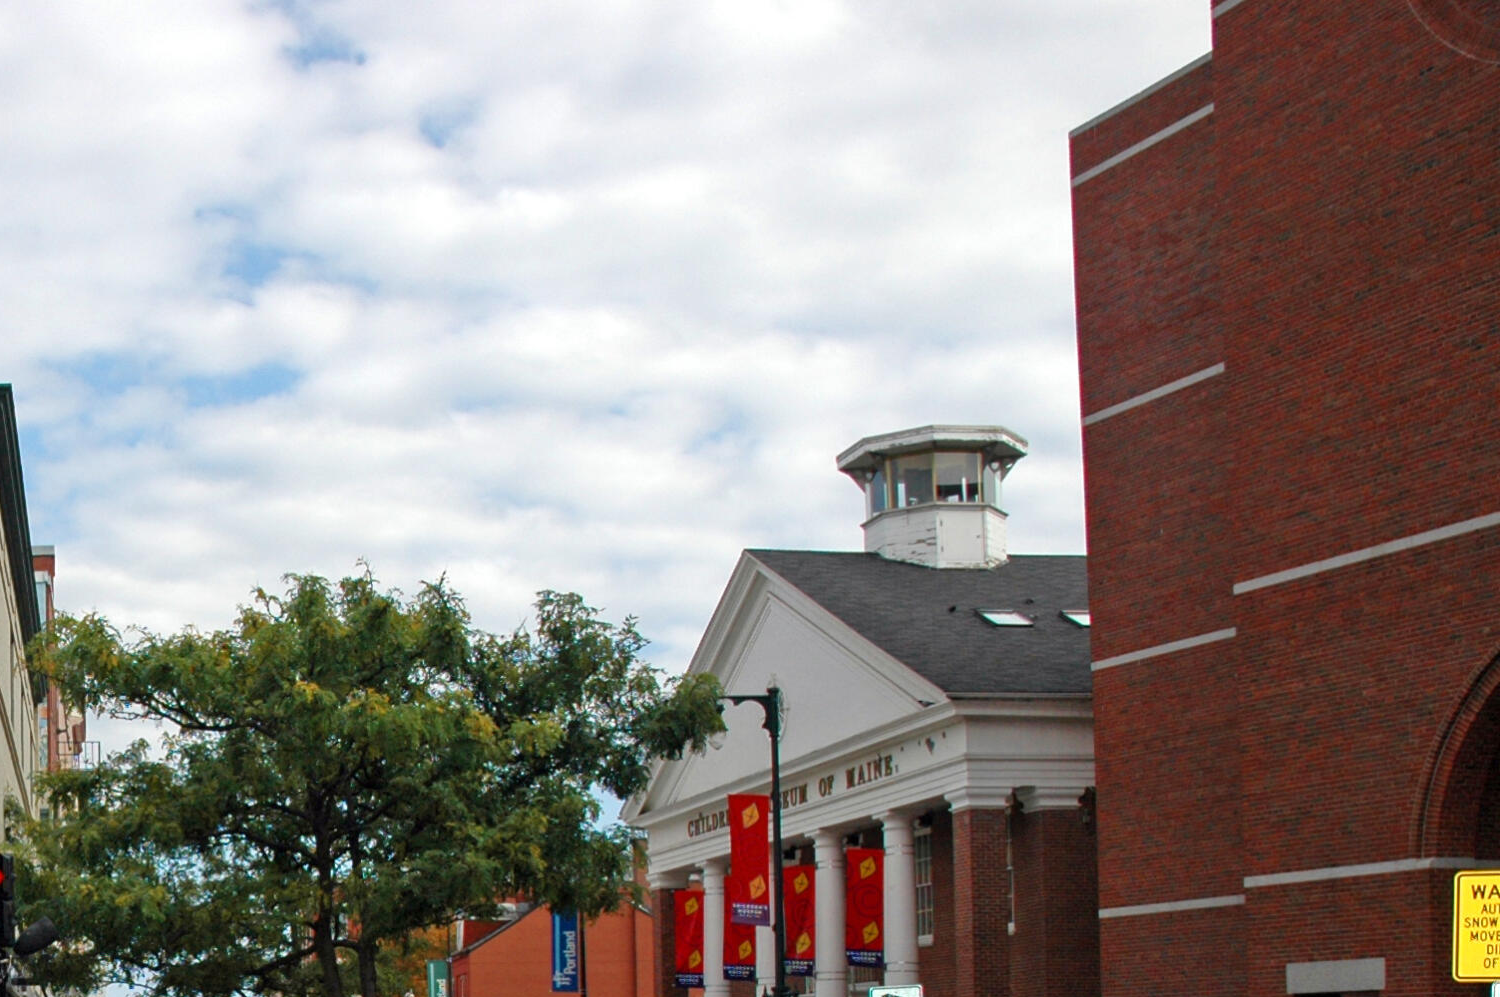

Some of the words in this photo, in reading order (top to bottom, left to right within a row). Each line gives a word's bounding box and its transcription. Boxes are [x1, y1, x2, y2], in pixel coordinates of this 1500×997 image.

[819, 775, 834, 797] OF
[845, 755, 893, 789] MAINE
[1465, 917, 1498, 929] SNOW
[563, 930, 576, 975] Portland
